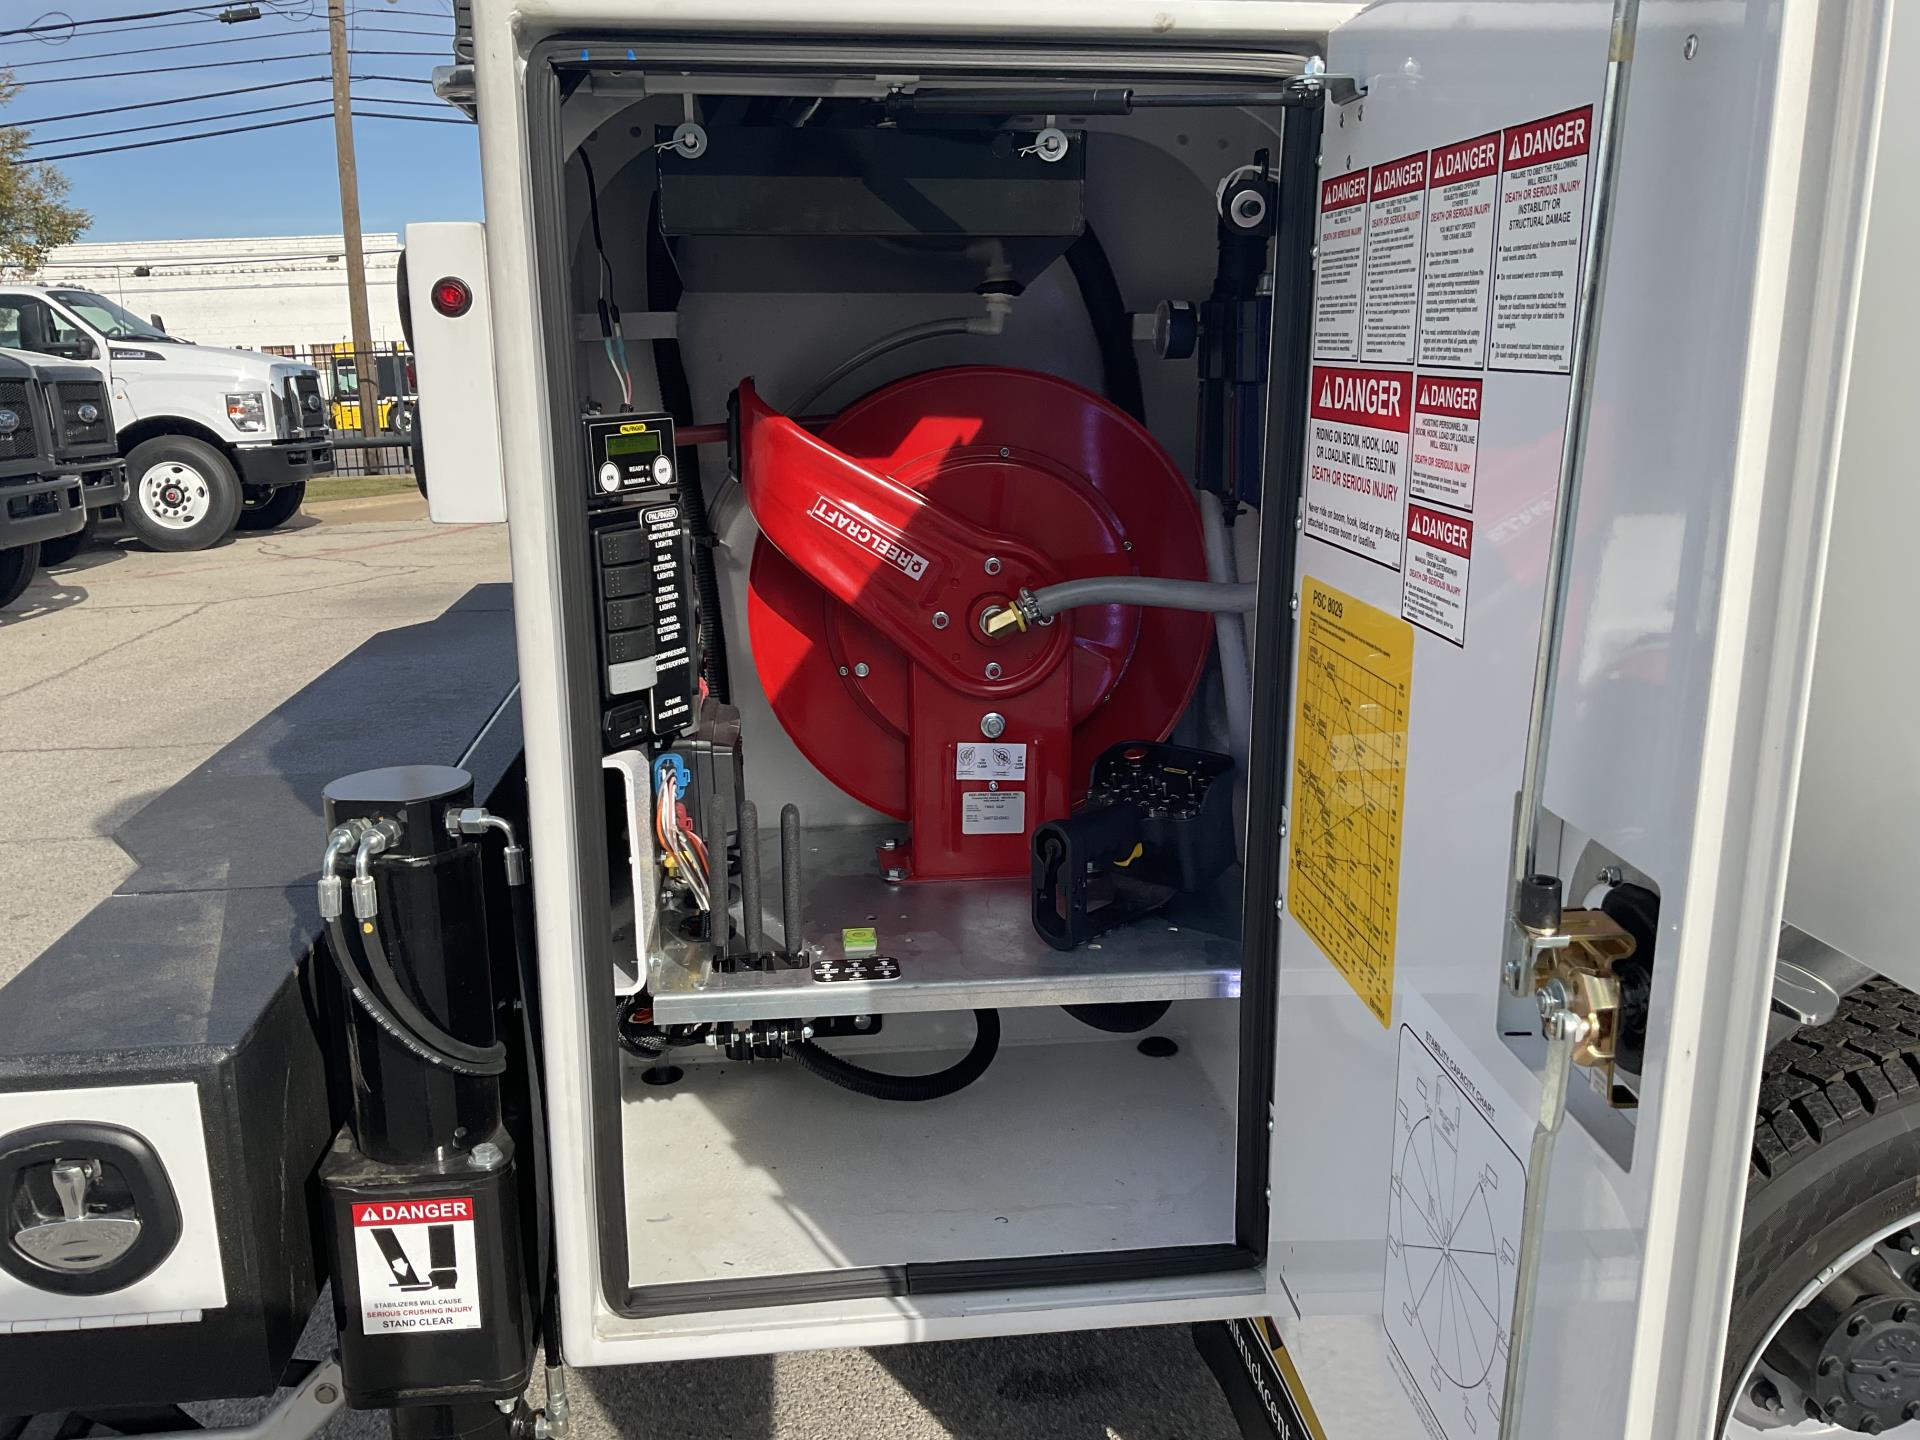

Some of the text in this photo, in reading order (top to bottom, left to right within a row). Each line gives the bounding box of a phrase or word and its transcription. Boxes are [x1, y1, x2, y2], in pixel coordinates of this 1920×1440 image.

[1523, 119, 1585, 157] DANGER
[1446, 143, 1495, 176] DANGER
[1384, 162, 1423, 190] DANGER
[1511, 170, 1526, 179] FAILURE
[1533, 166, 1543, 175] OBEY
[1553, 159, 1578, 171] FOLLOWING
[1332, 177, 1366, 202] DANGER
[1528, 177, 1537, 186] WILL
[1538, 175, 1553, 184] RESULT
[1505, 180, 1581, 203] DEATH OR SERIOUS INJURY
[1431, 203, 1490, 223] DEATH OR SERIOUS INJURY
[1519, 198, 1560, 214] INSTABILITY OR
[1509, 212, 1571, 230] STRUCTURAL DAMAGE
[1335, 377, 1401, 417] DANGER
[1431, 386, 1477, 410] DANGER
[1422, 418, 1468, 432] HOISTING PERSONNEL ON
[1316, 427, 1333, 442] RIDING
[1334, 430, 1341, 444] ON
[1362, 435, 1380, 451] HOOK,
[1382, 438, 1398, 454] LOAD
[1430, 440, 1438, 449] WILL
[1440, 442, 1453, 451] RESULT
[1439, 431, 1448, 440] LOAD
[1449, 432, 1455, 441] OR
[1456, 433, 1475, 444] LOADLINE
[1317, 446, 1396, 475] OR LOADLINE WILL RESULT IN
[1415, 454, 1470, 473] DEATH OR SERIOUS INJURY
[1312, 465, 1330, 484] DEATH
[1332, 470, 1341, 486] OR
[1342, 472, 1370, 494] SERIOUS
[1372, 480, 1398, 501] INJURY
[648, 510, 675, 520] PALFINGER
[1308, 502, 1319, 513] Never
[1360, 519, 1368, 531] load
[1369, 524, 1374, 532] or
[1375, 526, 1383, 538] any
[1384, 527, 1399, 542] device
[652, 522, 674, 531] INTERIOR
[814, 503, 912, 568] REELCRAFT
[1308, 518, 1323, 530] attached
[1324, 522, 1328, 532] to
[1329, 526, 1339, 535] crane
[1340, 527, 1352, 540] boom
[1353, 534, 1357, 542] or
[1422, 516, 1467, 549] DANGER
[655, 539, 672, 548] LIGHTS
[653, 561, 676, 572] EXTERIOR
[658, 554, 671, 562] REAR
[657, 571, 674, 580] LIGHTS
[1409, 568, 1461, 597] DEATH OR SERIOUS INJURY
[656, 592, 678, 603] EXTERIOR
[659, 584, 674, 593] FRONT
[659, 602, 676, 611] LIGHTS
[1313, 590, 1343, 618] PSC 8029
[657, 623, 680, 634] EXTERIOR
[660, 615, 677, 624] CARGO
[661, 632, 678, 642] LIGHTS
[665, 696, 681, 706] CRANE
[659, 704, 688, 719] HOUR METER
[1425, 1030, 1496, 1117] STABILITY CAPACITY CHART
[382, 1202, 468, 1220] DANGER
[374, 1300, 418, 1309] STABILIZERS
[383, 1317, 453, 1328] STAND CLEAR
